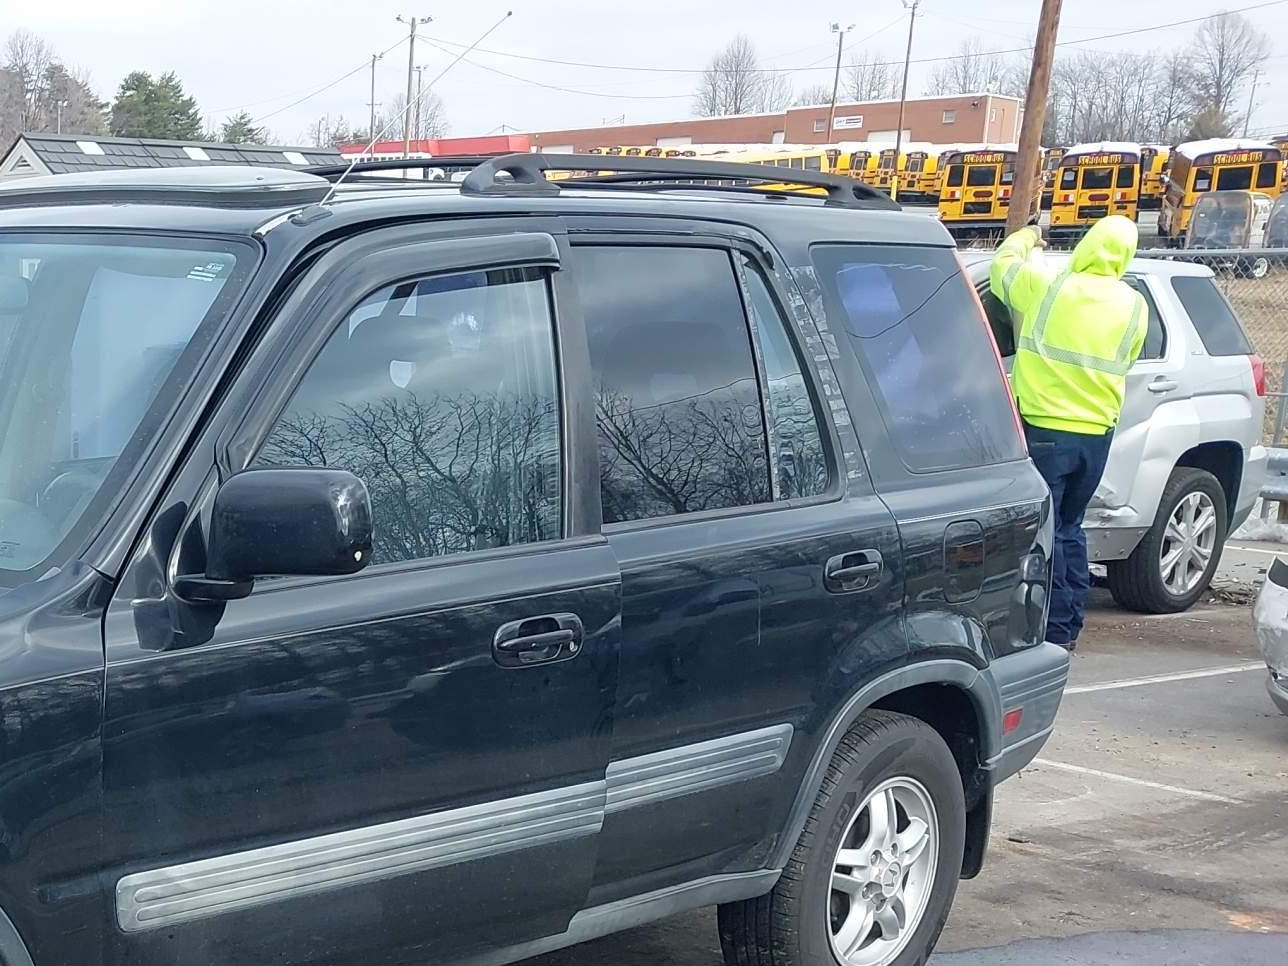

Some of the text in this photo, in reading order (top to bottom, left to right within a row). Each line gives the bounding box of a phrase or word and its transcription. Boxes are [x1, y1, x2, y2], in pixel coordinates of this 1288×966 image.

[964, 154, 987, 163] SCHOOL
[1079, 156, 1104, 165] SCHOOL
[1214, 152, 1263, 164] SCHOOL BUS
